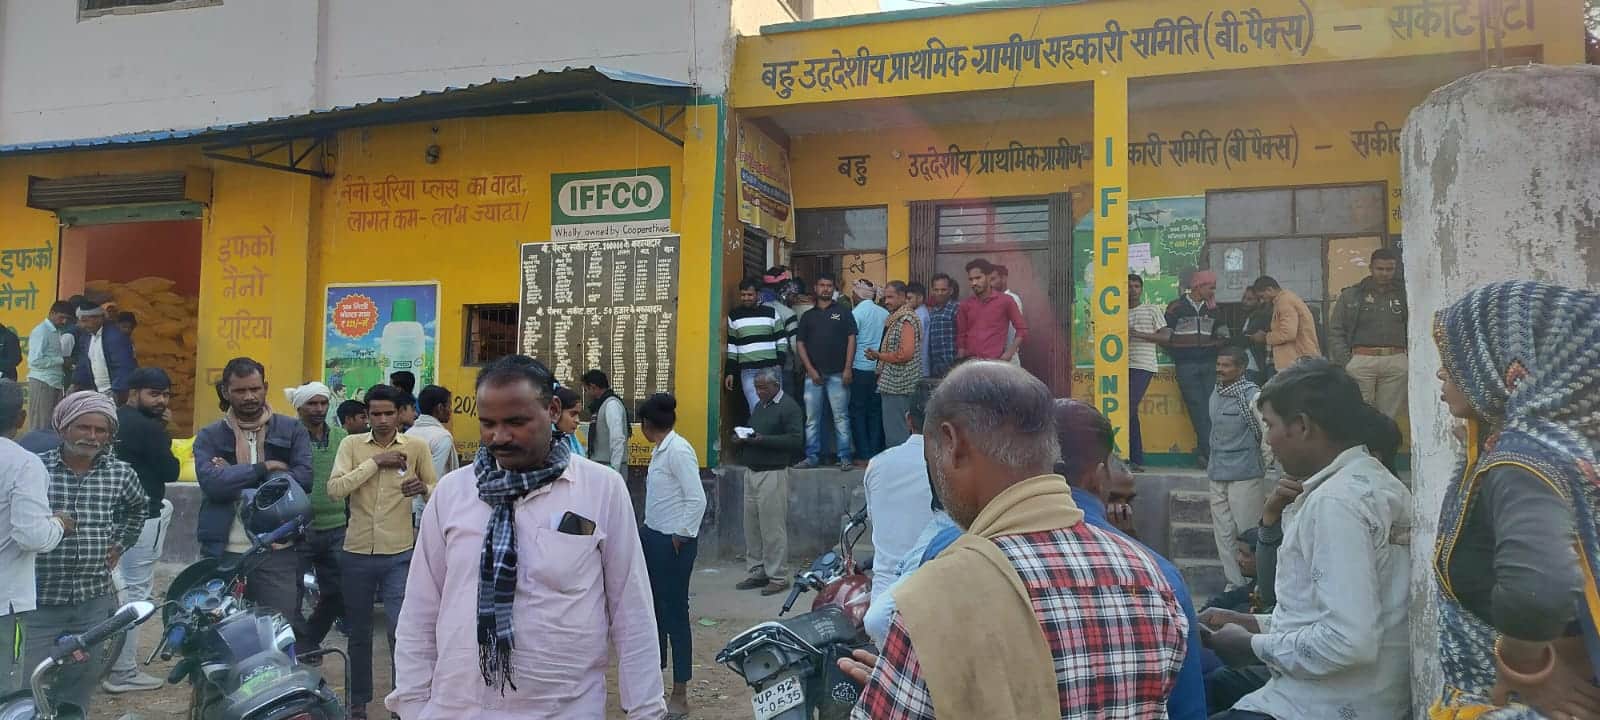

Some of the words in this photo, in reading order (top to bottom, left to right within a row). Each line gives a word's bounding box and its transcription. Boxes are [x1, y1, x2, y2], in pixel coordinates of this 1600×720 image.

[761, 61, 797, 99] बहु
[888, 37, 968, 81] प्राथमिक
[972, 33, 1043, 73] ग्रामीण
[1044, 20, 1128, 69] सहकारी
[1130, 10, 1203, 58] समिति
[838, 154, 870, 186] बहु
[976, 141, 1039, 175] प्राथमिक
[1168, 129, 1221, 166] समिति
[341, 174, 369, 205] नैनो
[373, 175, 415, 208] यूरिया
[422, 176, 459, 200] प्लस
[467, 176, 490, 198] का
[570, 181, 652, 211] IFFCO
[347, 209, 391, 233] लागत
[432, 204, 467, 227] लाभ
[554, 227, 582, 239] Wholly
[585, 224, 609, 237] owned
[622, 222, 669, 234] Cooperatives
[1, 240, 53, 278] इफको
[218, 225, 277, 264] इफको
[222, 265, 271, 299] नैनो
[217, 310, 273, 349] यूरिया
